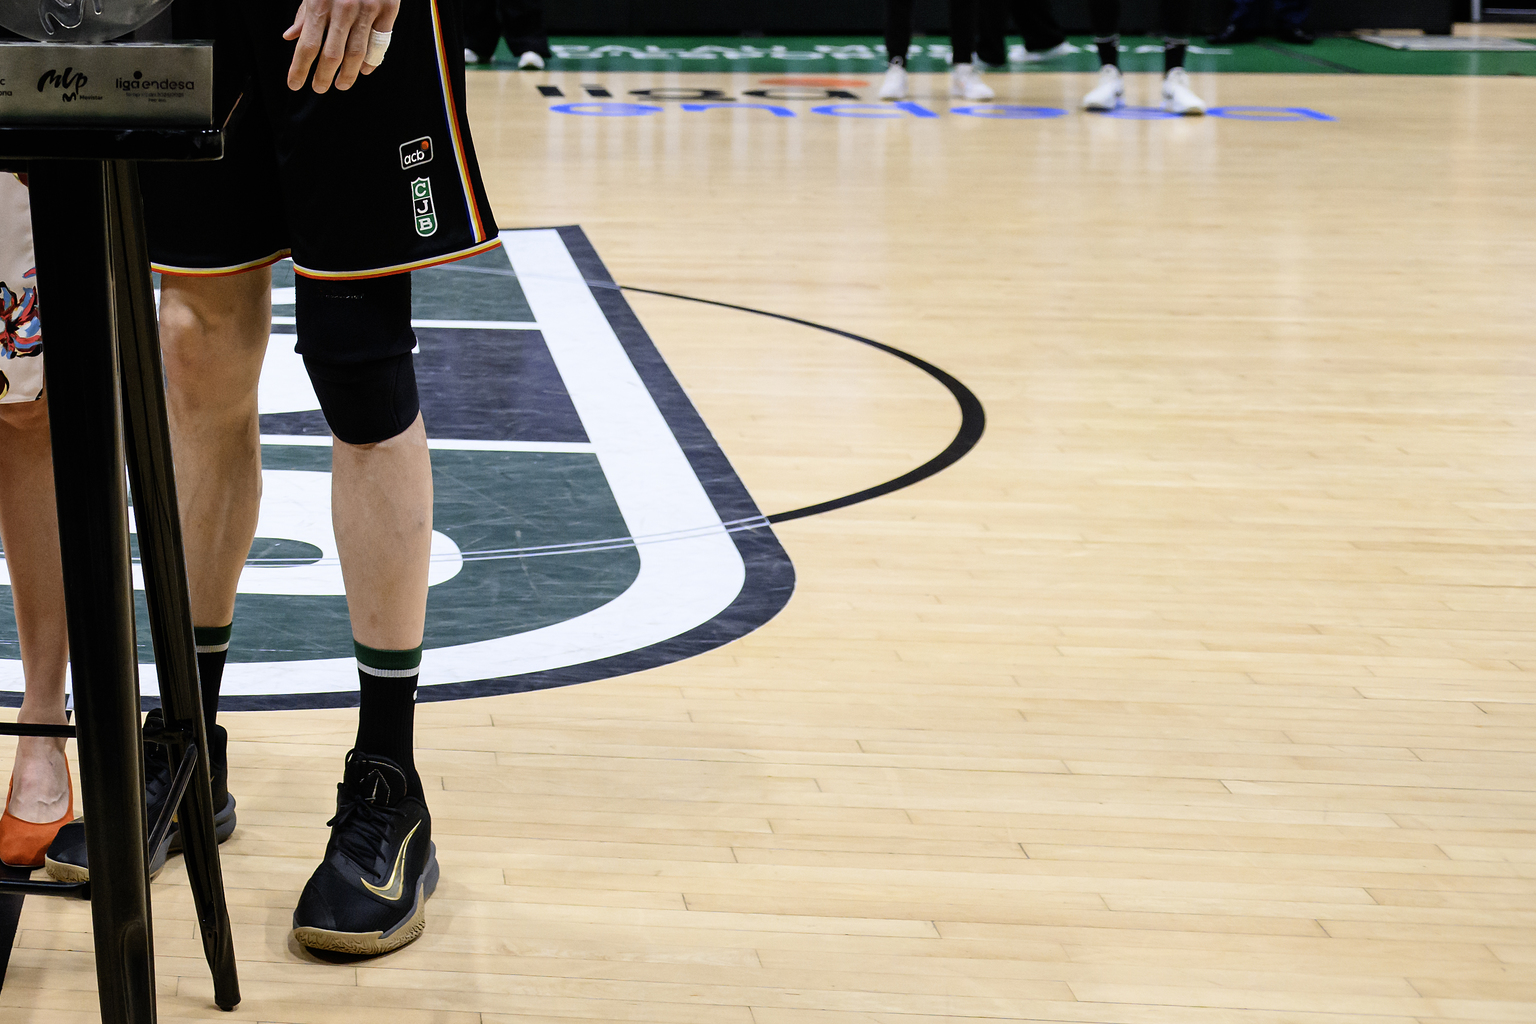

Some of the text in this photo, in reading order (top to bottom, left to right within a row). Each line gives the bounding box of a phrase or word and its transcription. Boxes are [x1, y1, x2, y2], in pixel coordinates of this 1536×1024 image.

[115, 77, 195, 91] liga endesa
[403, 149, 425, 165] acb
